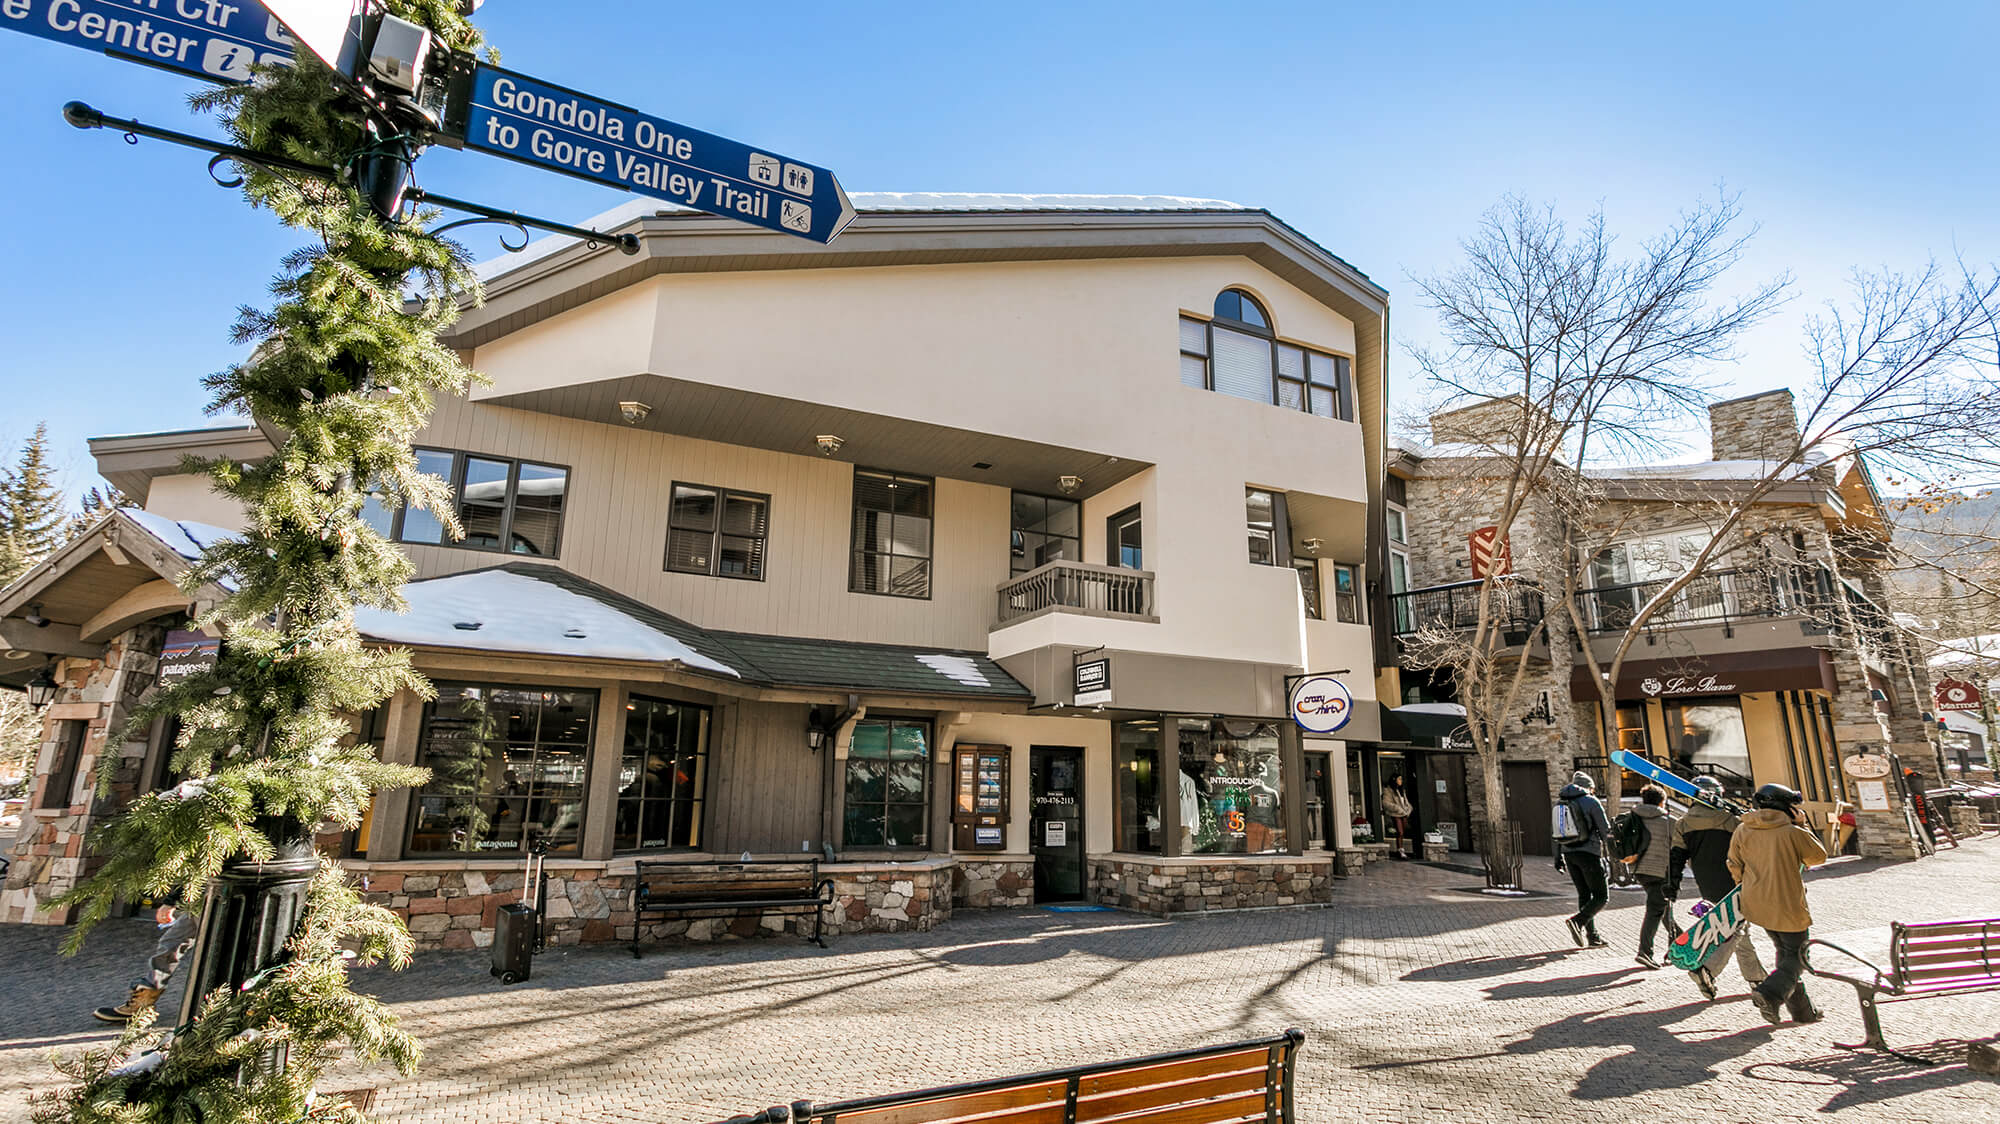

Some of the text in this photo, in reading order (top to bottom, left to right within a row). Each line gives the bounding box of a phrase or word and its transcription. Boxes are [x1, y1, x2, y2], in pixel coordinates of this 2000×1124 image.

[47, 0, 198, 62] Center
[492, 78, 693, 161] Gondola One
[486, 115, 770, 220] to Gore Valley Trail
[1662, 674, 1737, 695] Loro Piana
[1303, 695, 1326, 705] crazy
[1940, 701, 1980, 710] Marmot
[475, 839, 518, 849] patagonia
